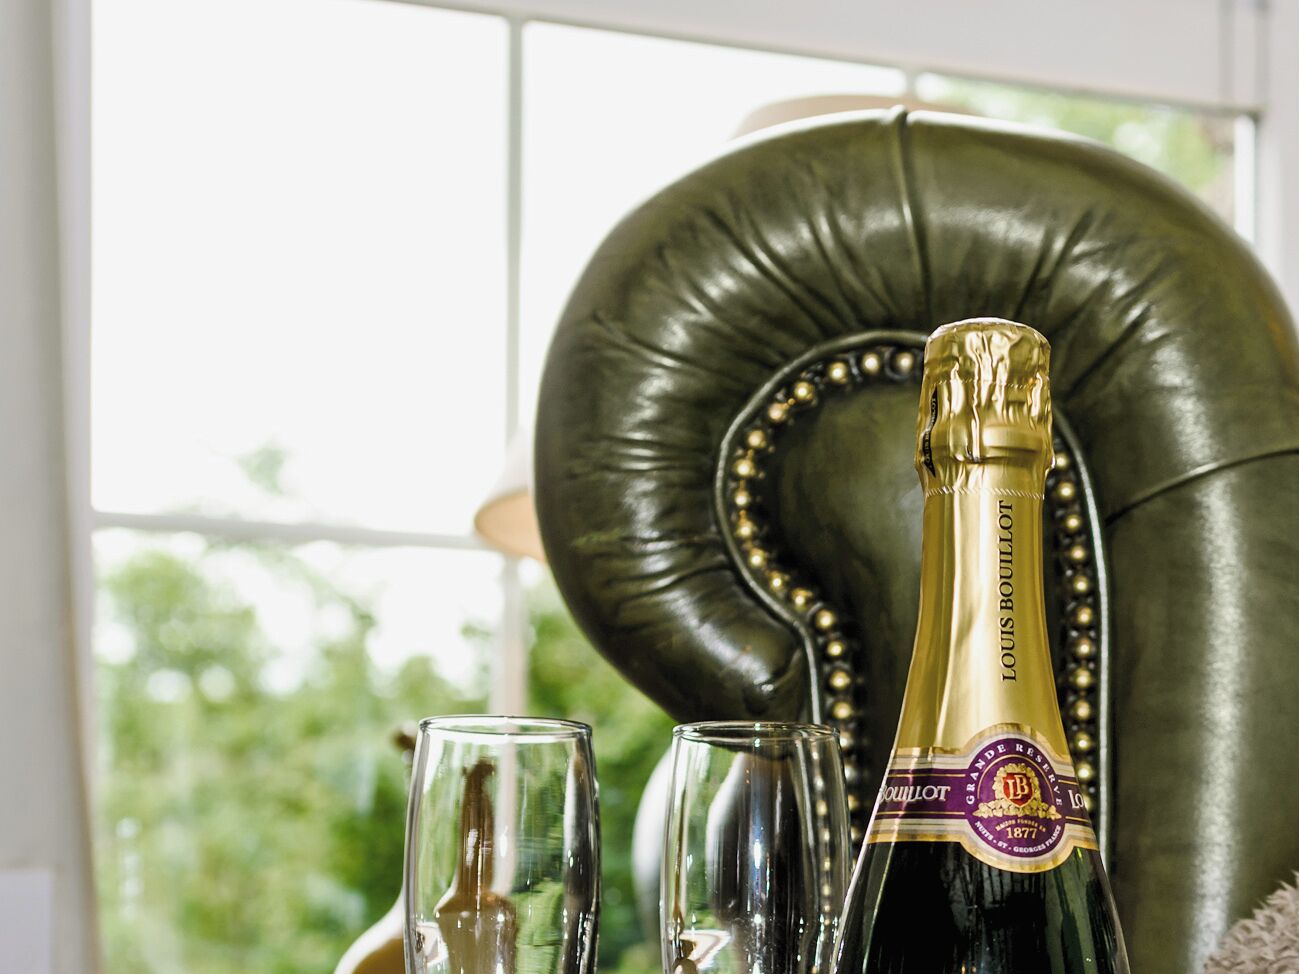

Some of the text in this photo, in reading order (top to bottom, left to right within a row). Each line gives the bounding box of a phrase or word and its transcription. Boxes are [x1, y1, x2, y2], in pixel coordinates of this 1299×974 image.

[998, 500, 1017, 682] LOUIS BOUILLOT
[966, 743, 1007, 805] GRANDE
[974, 820, 994, 842] NUITS
[1013, 843, 1046, 853] GEORGES
[1045, 824, 1062, 847] FRANCE
[1005, 827, 1038, 839] 1877
